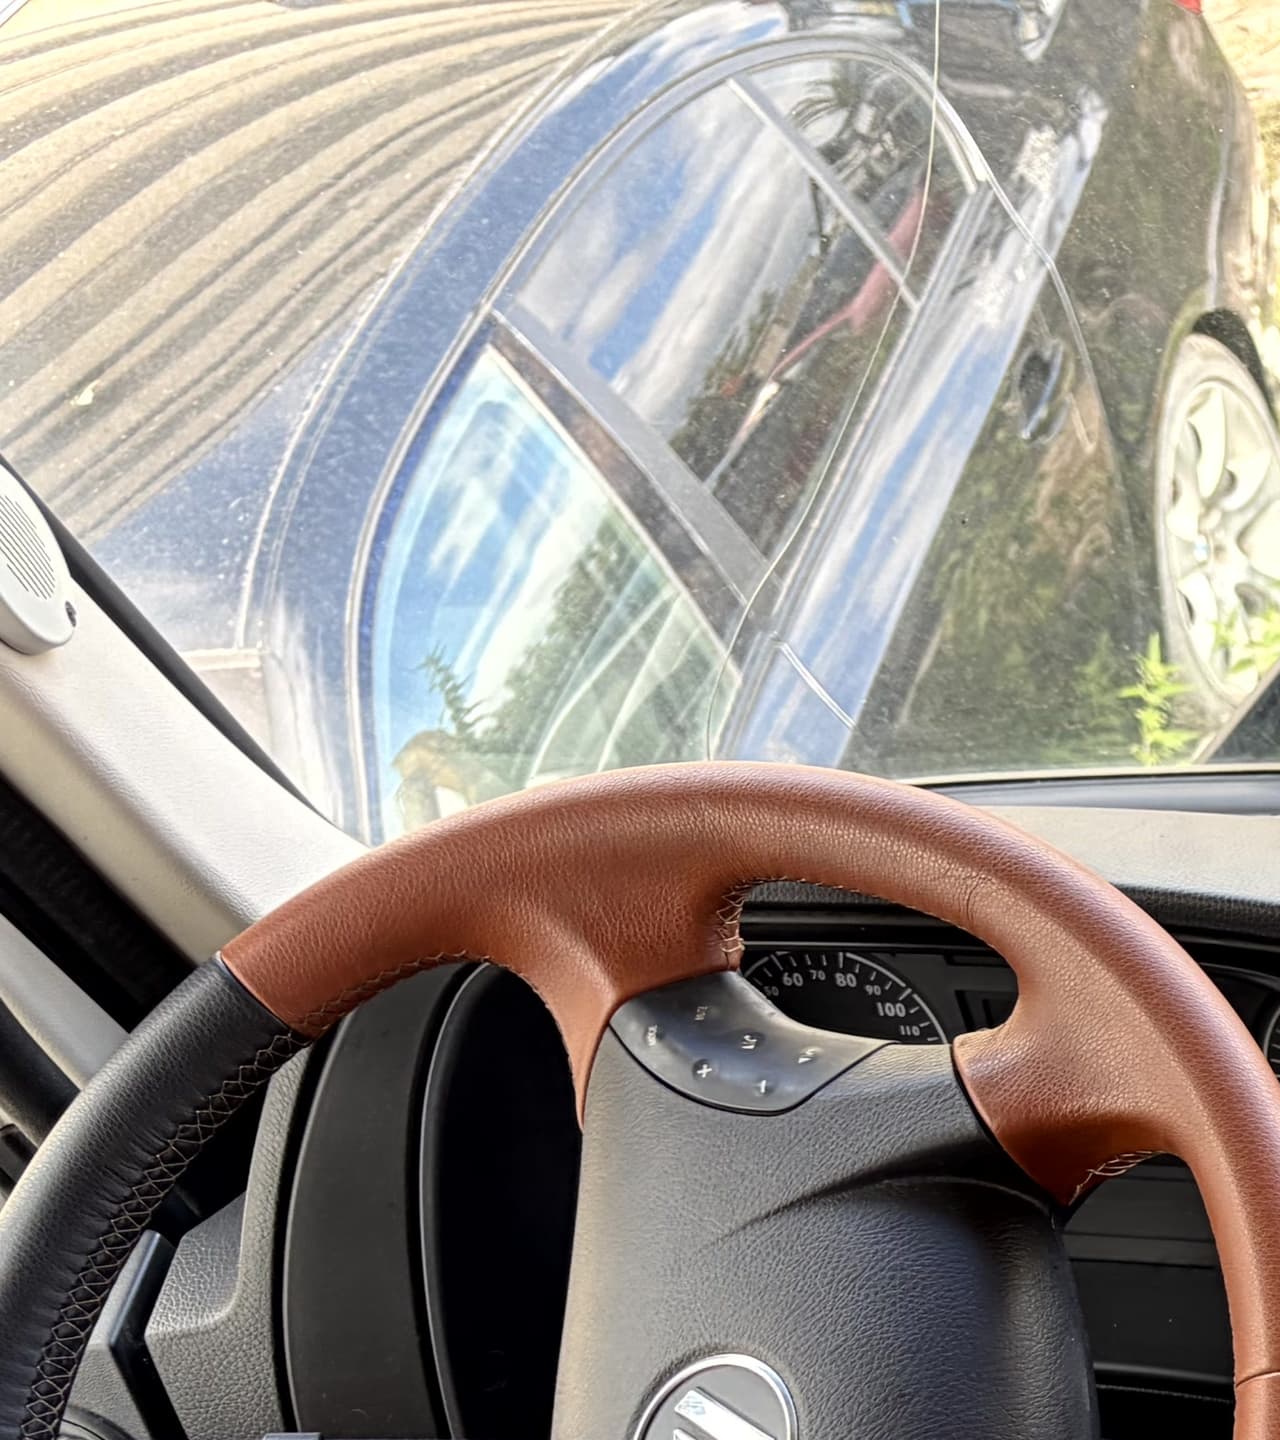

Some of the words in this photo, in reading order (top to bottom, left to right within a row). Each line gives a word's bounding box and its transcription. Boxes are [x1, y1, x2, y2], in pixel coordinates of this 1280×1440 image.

[782, 972, 804, 987] 60
[809, 969, 826, 980] 70
[835, 973, 857, 987] 80
[865, 984, 881, 996] 90
[876, 1002, 906, 1017] 100
[900, 1025, 920, 1036] 110
